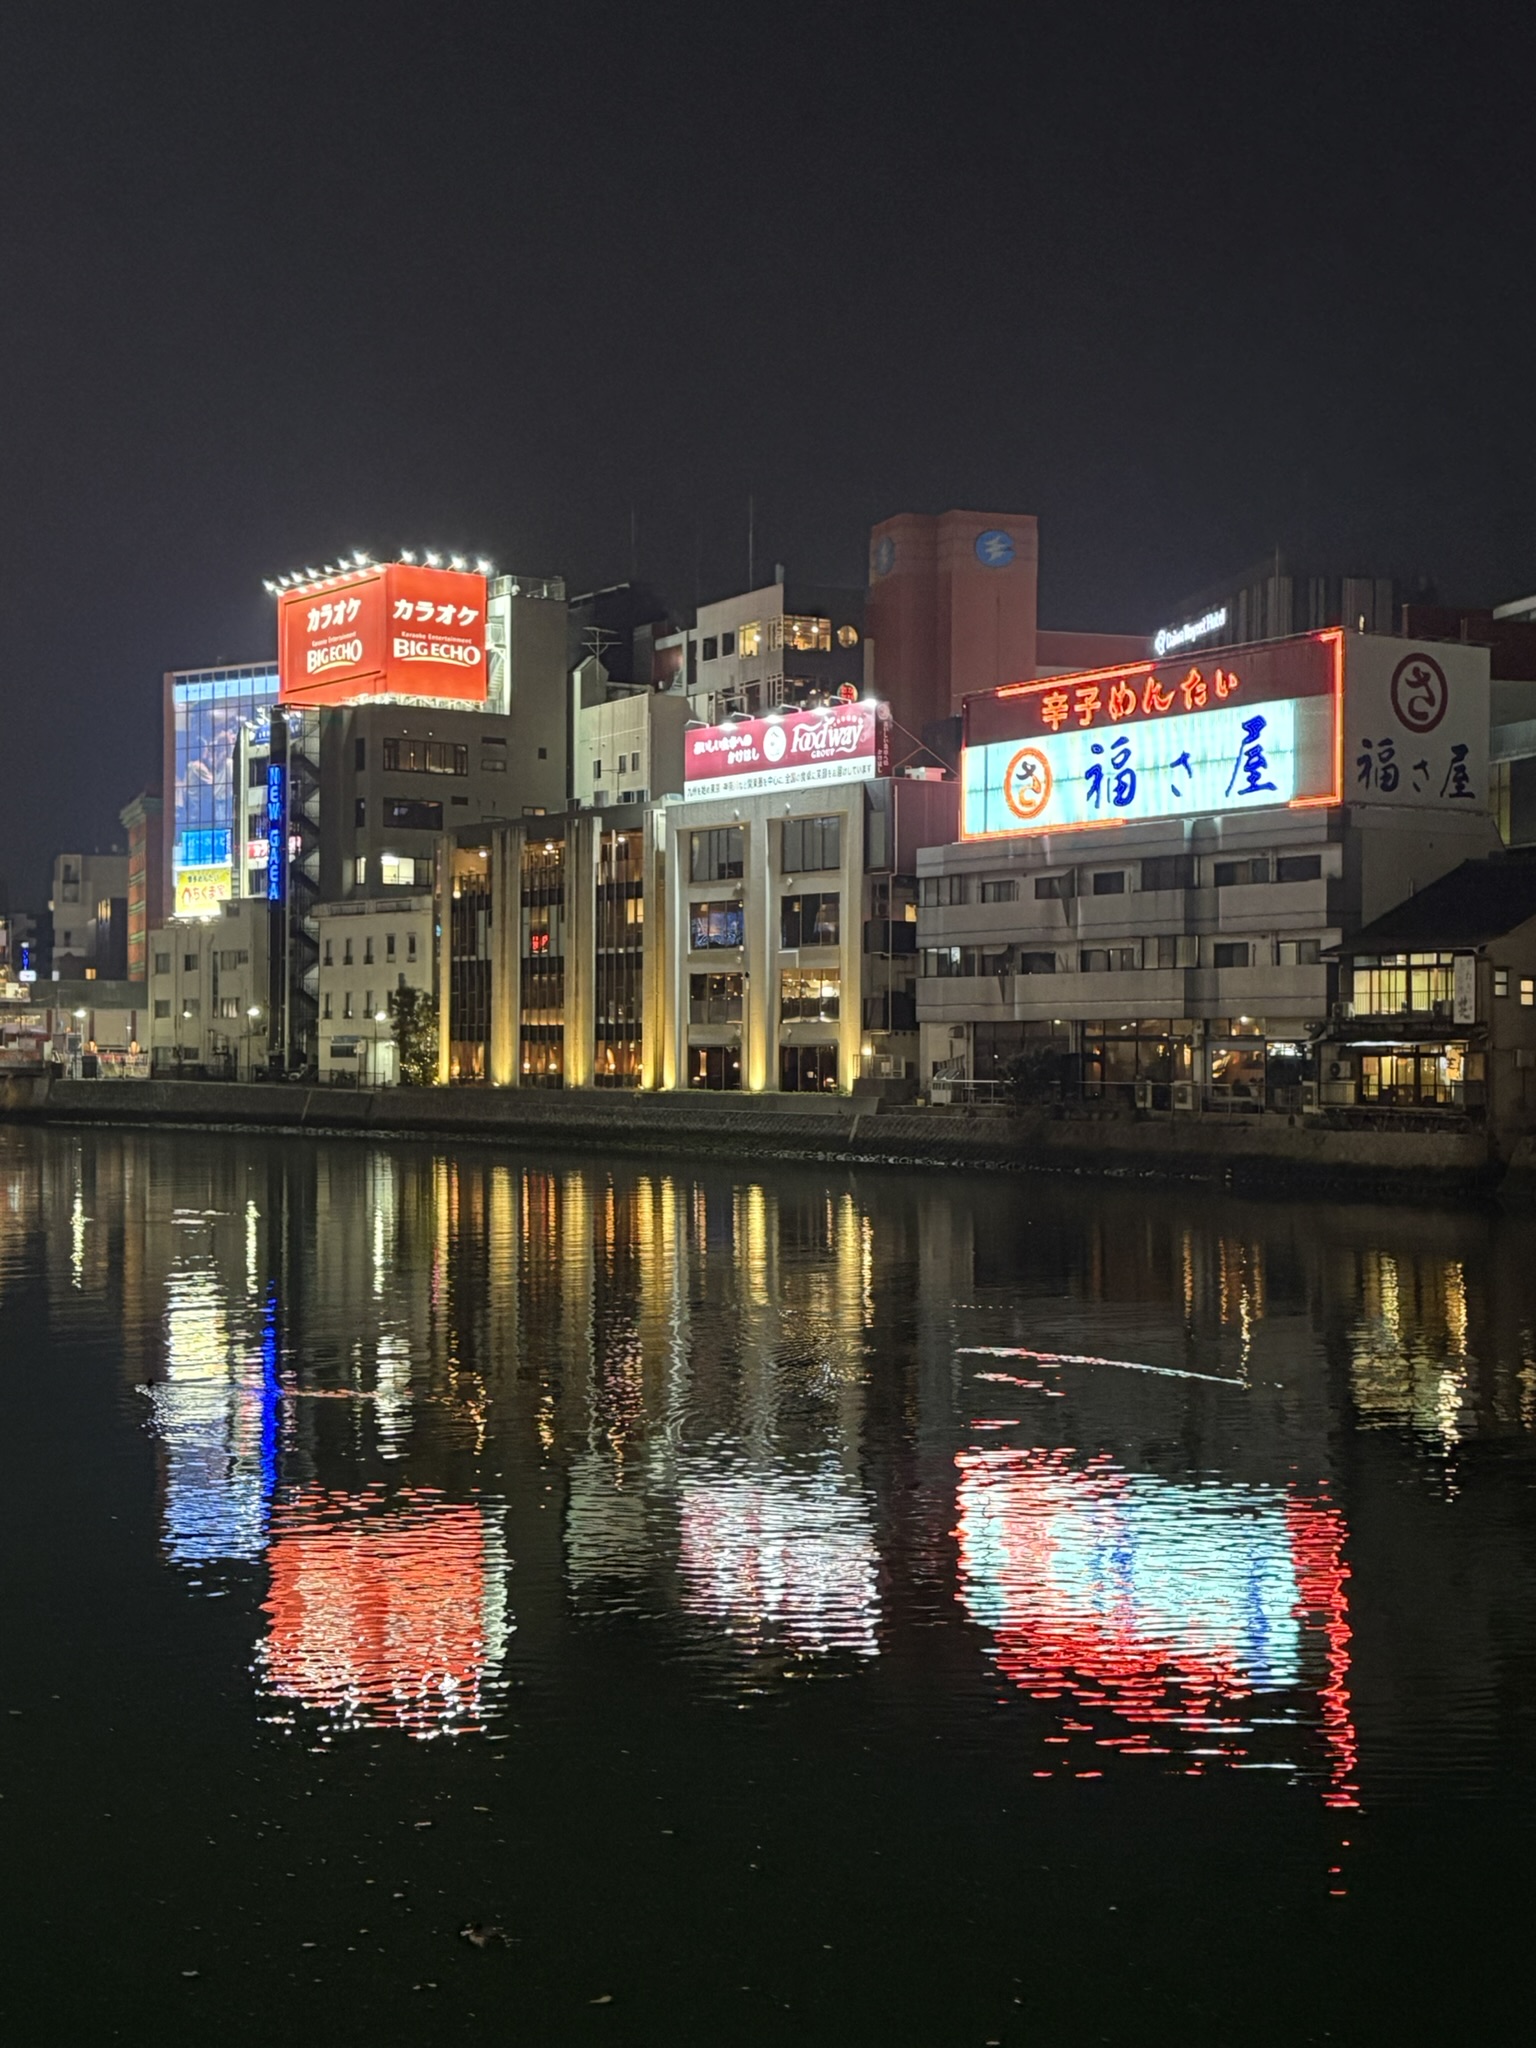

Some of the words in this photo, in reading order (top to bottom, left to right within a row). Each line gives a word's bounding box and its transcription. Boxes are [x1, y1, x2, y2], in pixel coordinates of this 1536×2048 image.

[307, 598, 361, 632] カラオケ
[393, 599, 479, 626] カラオケ
[1207, 607, 1226, 631] Hotel
[393, 637, 428, 658] BIG
[430, 643, 481, 665] ECHO
[401, 631, 427, 640] Karaoke
[428, 633, 472, 645] Entertainment
[307, 646, 329, 674] BIG
[330, 638, 363, 663] ECHO
[1041, 667, 1237, 731] 辛子めんたい
[811, 748, 836, 760] GROUP
[1085, 715, 1277, 809] 福さ屋
[1357, 738, 1476, 800] 福さ屋
[269, 766, 280, 820] NEW
[269, 830, 280, 900] GAEA
